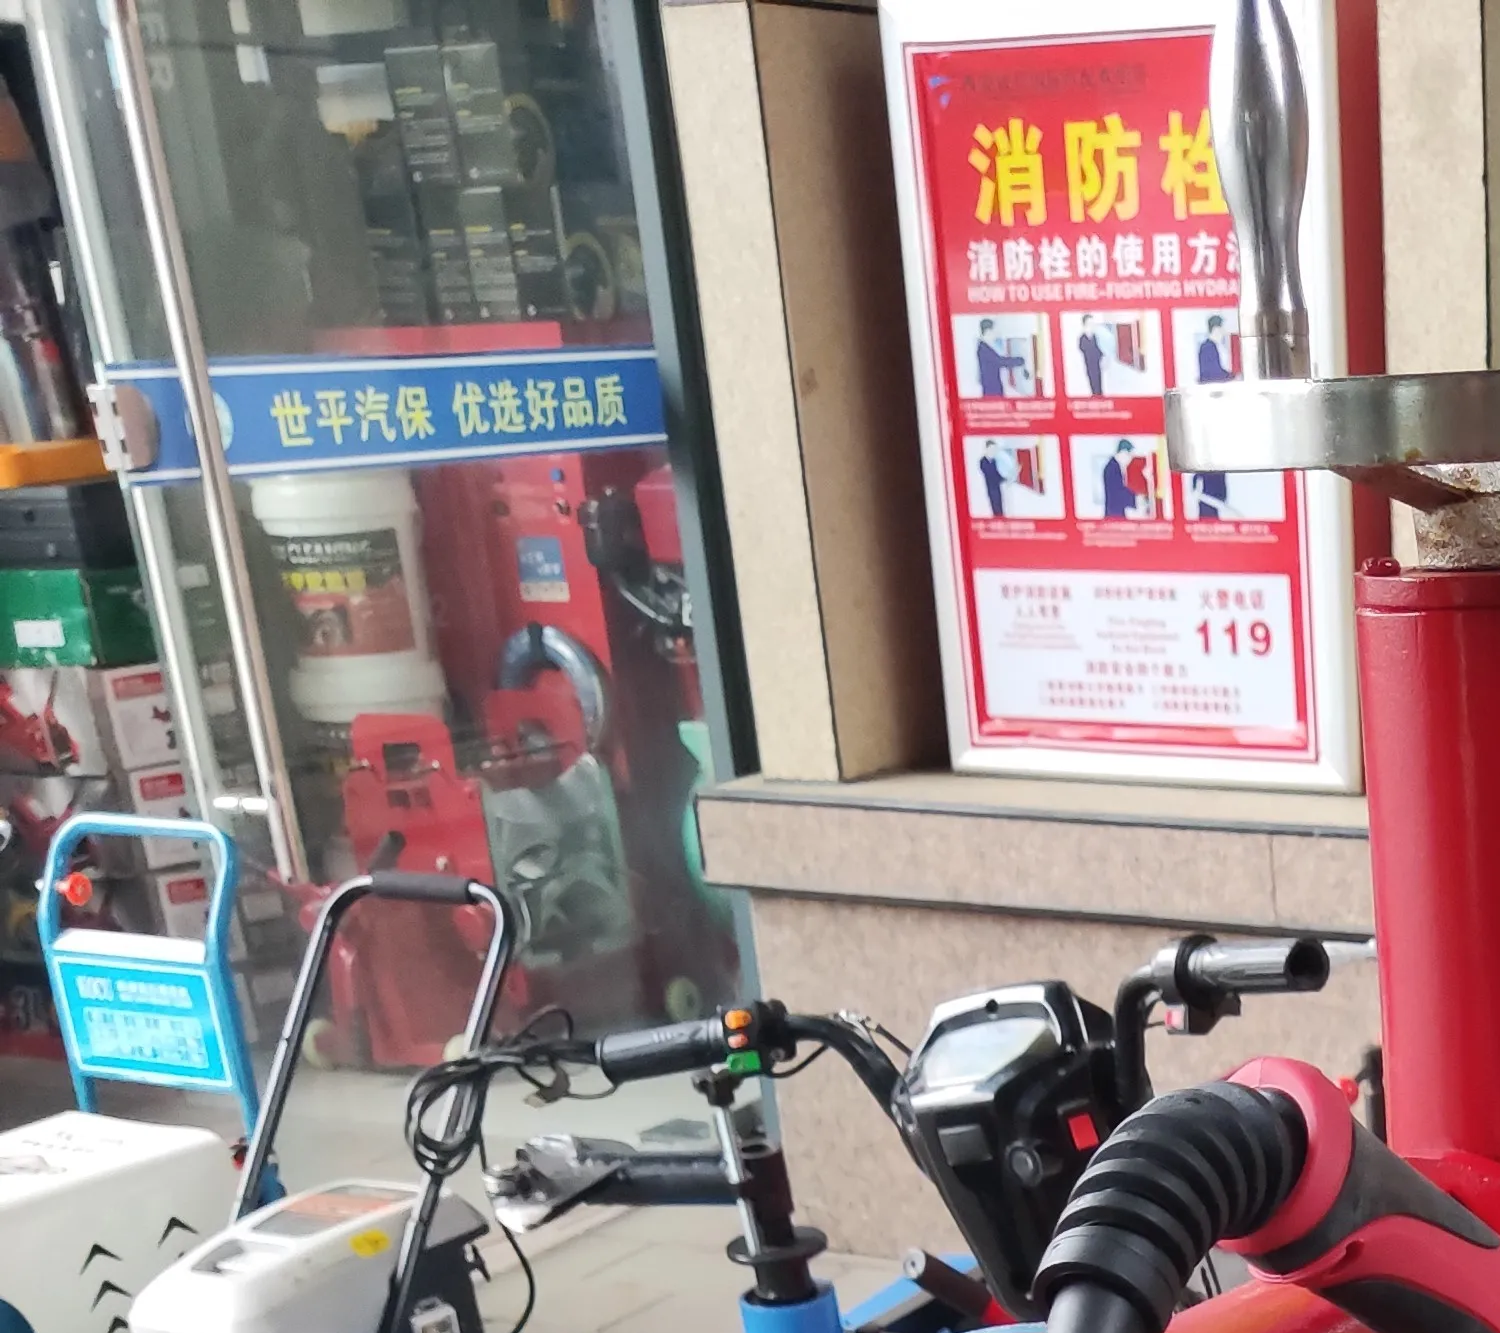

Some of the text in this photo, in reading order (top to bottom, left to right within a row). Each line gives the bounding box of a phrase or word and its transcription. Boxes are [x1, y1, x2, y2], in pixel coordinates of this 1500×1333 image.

[968, 108, 1229, 227] 消防栓
[968, 286, 1006, 304] HOW
[1008, 284, 1030, 302] TO
[1031, 283, 1064, 301] USE
[1183, 278, 1241, 298] HYDRA
[270, 373, 628, 447] 世平汽保 优选好品质
[1196, 618, 1273, 657] 119
